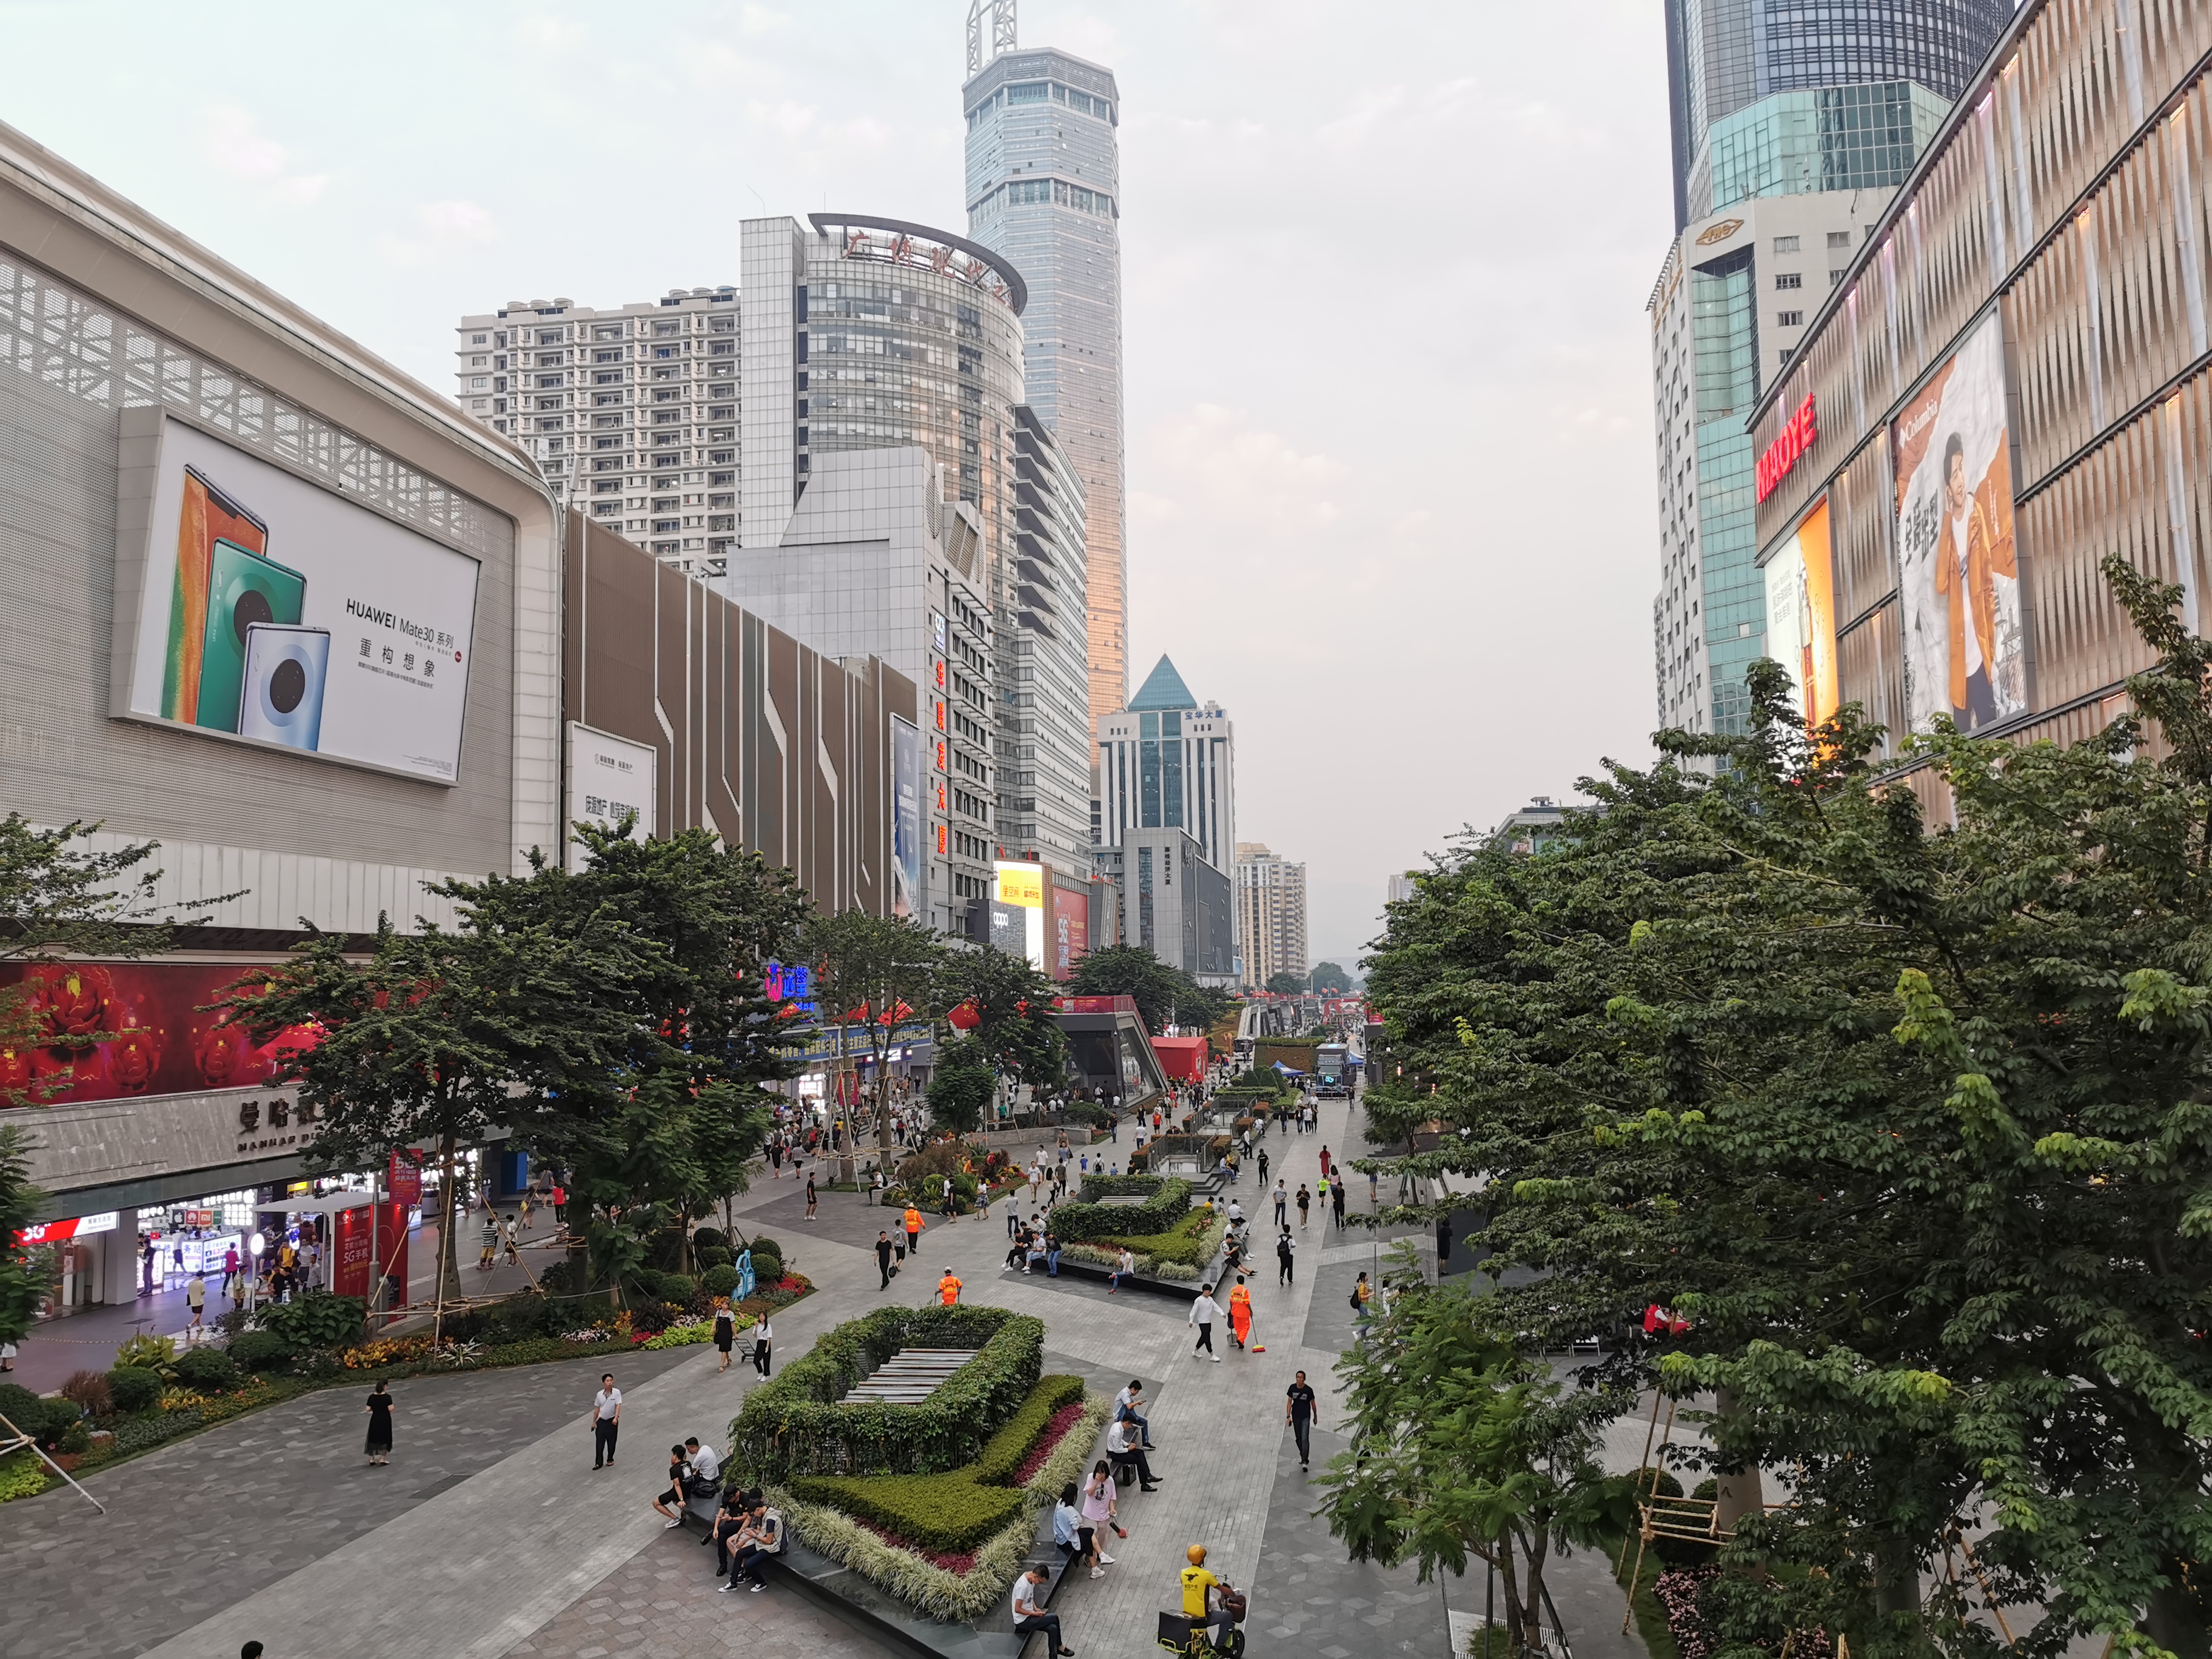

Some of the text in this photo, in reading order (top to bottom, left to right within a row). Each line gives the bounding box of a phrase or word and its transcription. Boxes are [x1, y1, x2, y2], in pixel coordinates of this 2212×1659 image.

[1905, 398, 1938, 441] Columbia
[1756, 392, 1815, 504] MAOYE
[346, 598, 454, 649] HUAWEI Mate30 系列
[359, 637, 435, 677] 重构想象
[1184, 709, 1224, 720] 宝华大厦
[993, 911, 1008, 930] oppo
[1324, 1075, 1335, 1084] 5G
[237, 1135, 296, 1152] MANHAR
[343, 1247, 368, 1264] 5G手机
